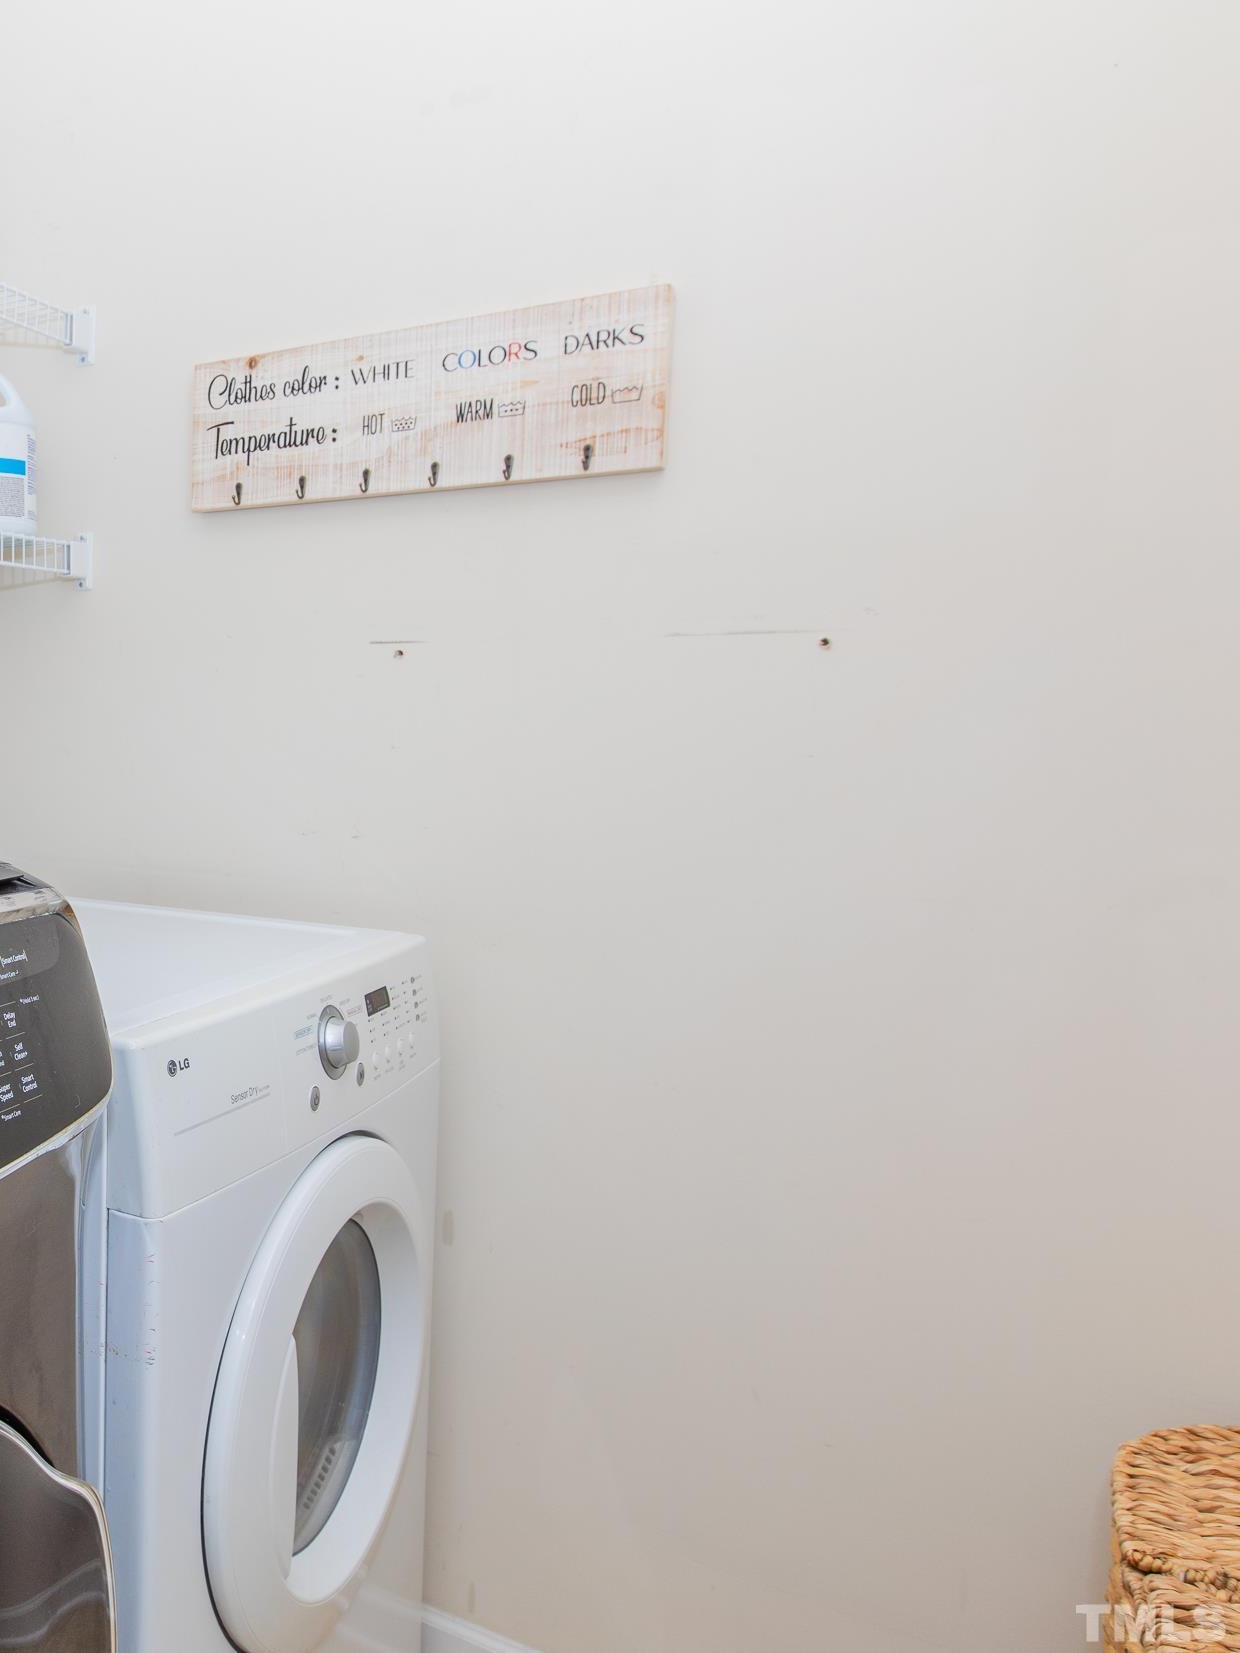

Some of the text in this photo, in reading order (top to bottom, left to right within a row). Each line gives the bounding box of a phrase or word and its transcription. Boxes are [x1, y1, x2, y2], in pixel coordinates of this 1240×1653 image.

[208, 374, 276, 410] Clothes
[350, 359, 416, 385] WHITE
[442, 340, 538, 372] COLORS
[564, 323, 645, 355] DARKS
[362, 413, 385, 436] HOT
[456, 398, 494, 423] WARM
[571, 381, 606, 408] COLD
[178, 1058, 190, 1070] LG
